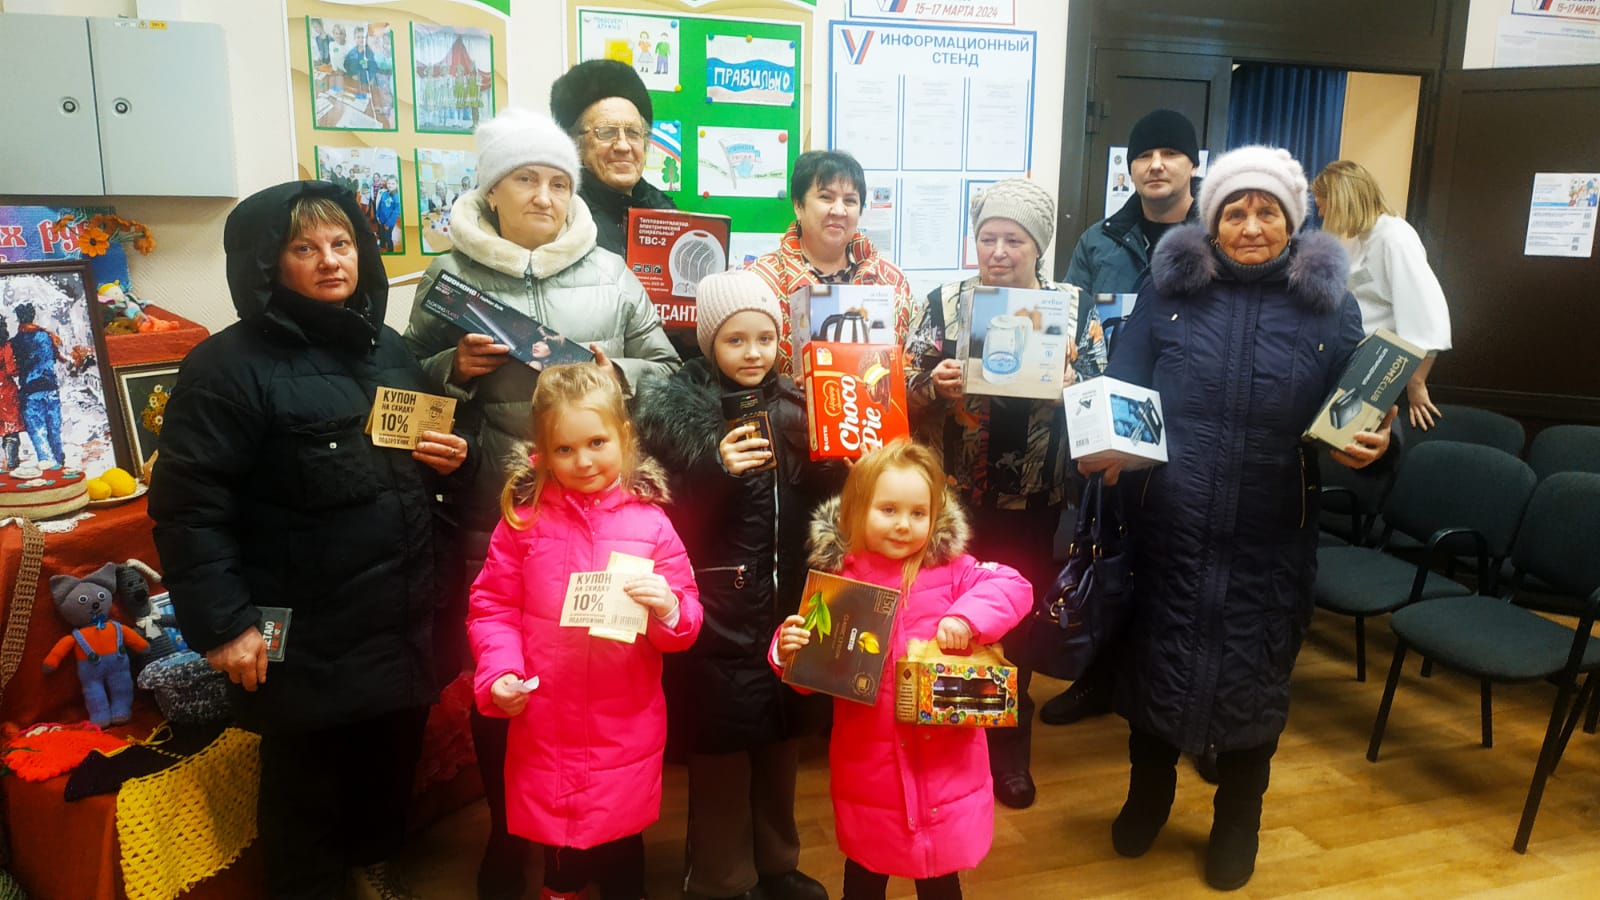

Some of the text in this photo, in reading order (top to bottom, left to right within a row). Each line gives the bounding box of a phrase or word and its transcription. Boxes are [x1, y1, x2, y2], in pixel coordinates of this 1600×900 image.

[942, 5, 974, 16] МАРТА
[975, 6, 998, 17] 2024
[880, 33, 1030, 52] ИНФОРМАЦИОННЫЙ
[932, 52, 979, 67] СТЕНД
[713, 66, 791, 91] ПРАВИЛЬНО
[639, 236, 667, 246] ТВС-2
[654, 303, 698, 322] ЕСАНТ
[383, 389, 417, 405] КУПОН
[381, 403, 415, 414] НА СКИДКУ
[838, 375, 860, 451] Choco
[381, 413, 409, 433] 10%
[861, 407, 883, 453] Pie
[576, 573, 612, 585] КУПОН
[585, 584, 610, 592] СКИДКУ
[573, 593, 604, 612] 10%
